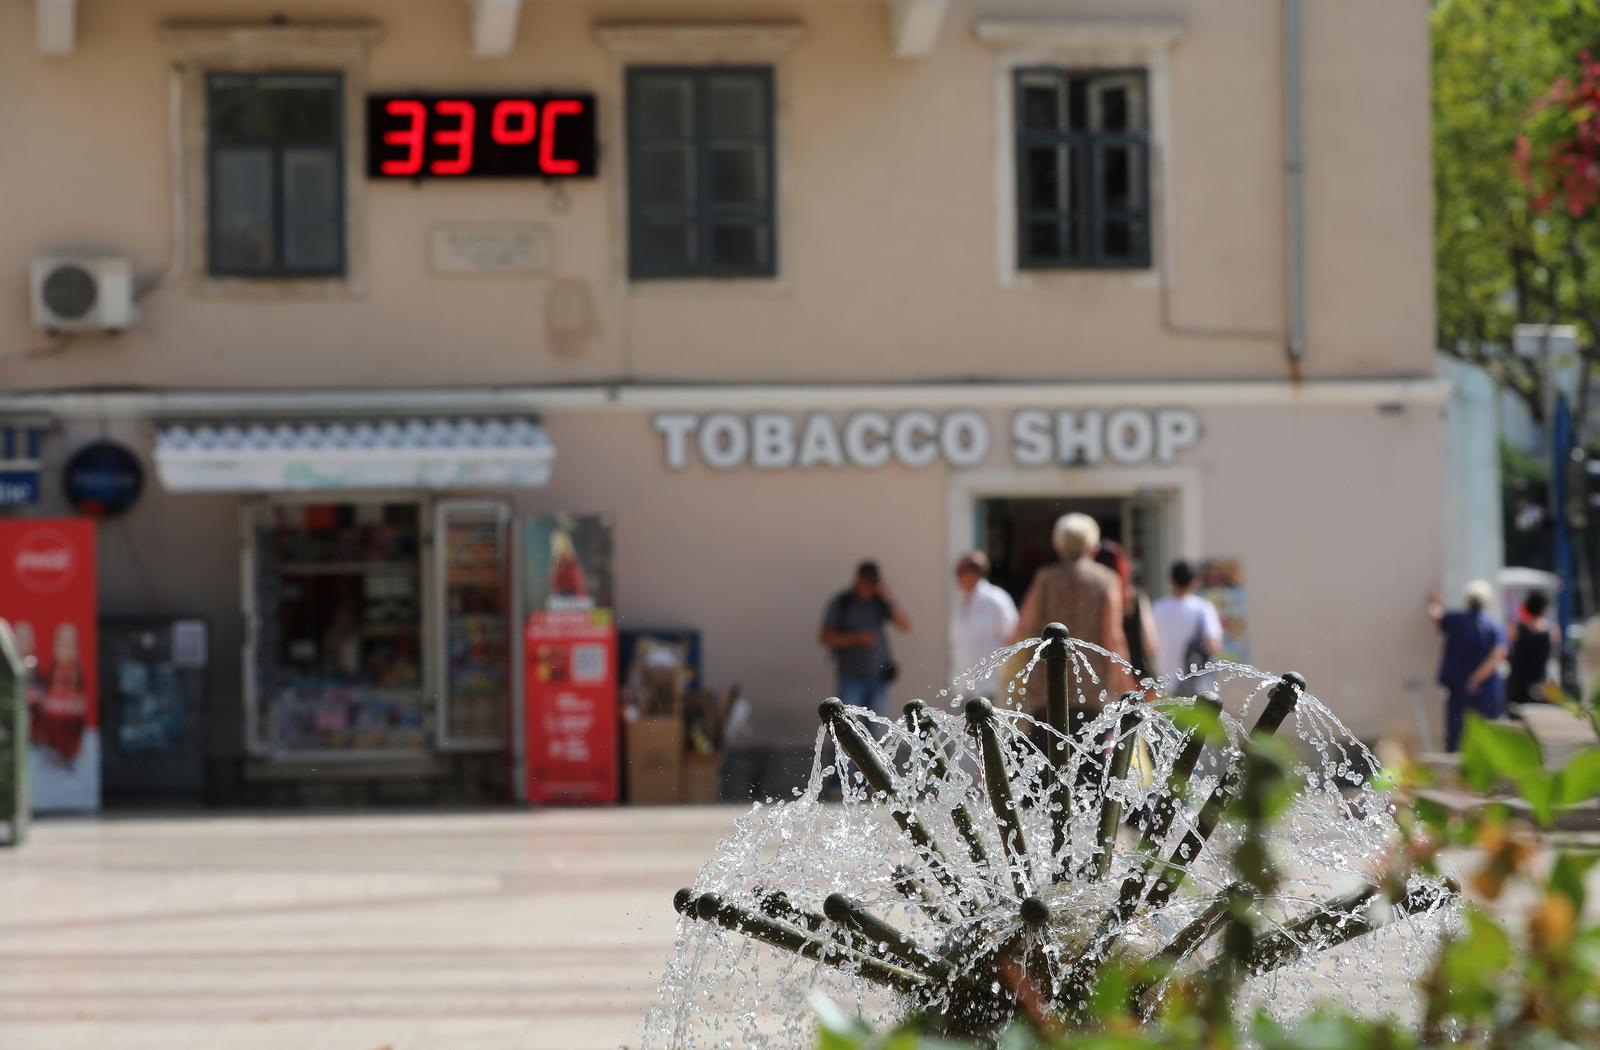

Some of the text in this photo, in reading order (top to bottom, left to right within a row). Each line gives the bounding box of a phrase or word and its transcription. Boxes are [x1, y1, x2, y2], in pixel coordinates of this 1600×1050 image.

[381, 100, 476, 175] 33
[653, 407, 1201, 470] TOBACCO SHOP
